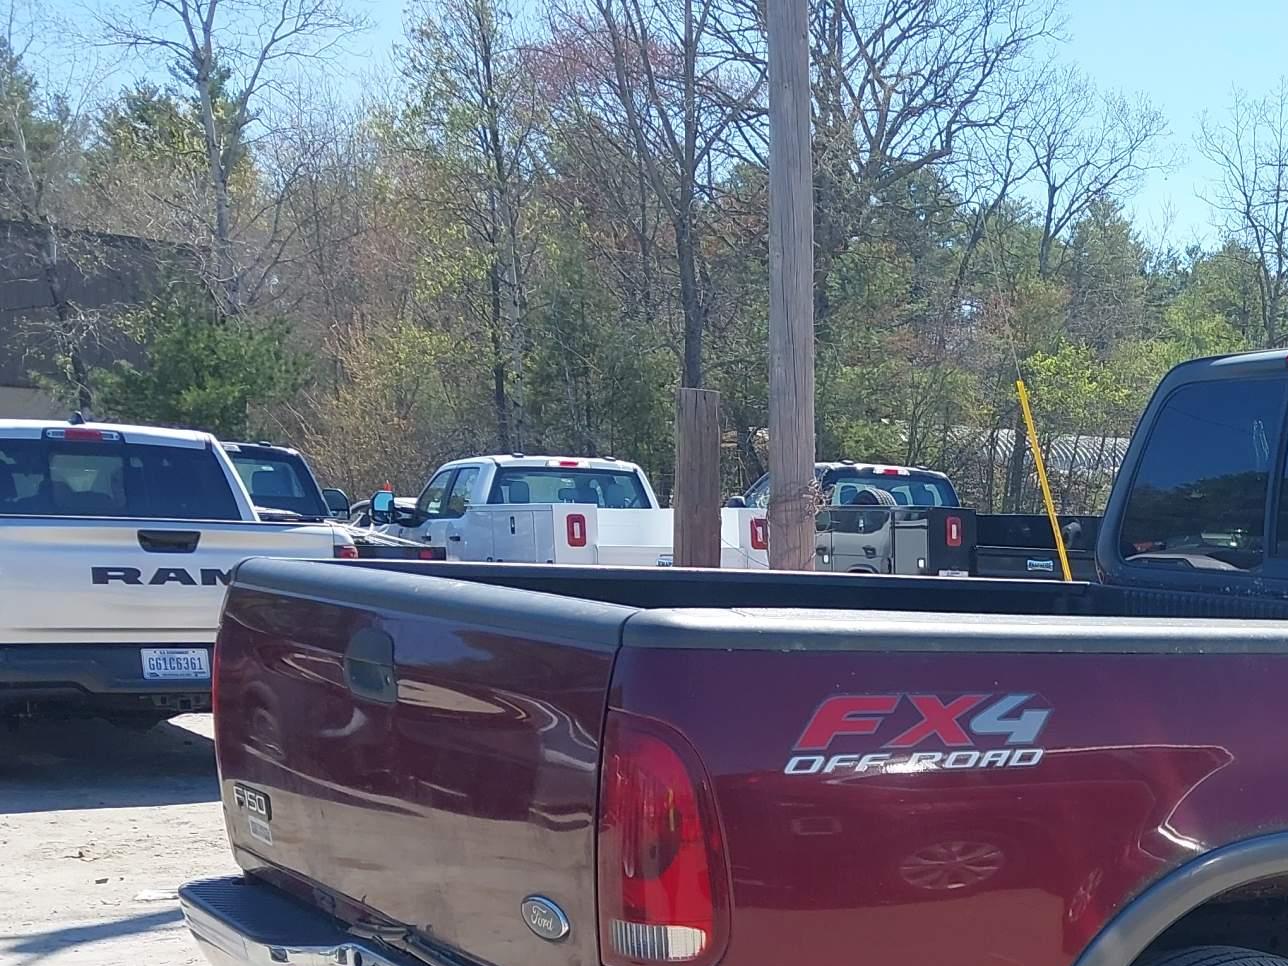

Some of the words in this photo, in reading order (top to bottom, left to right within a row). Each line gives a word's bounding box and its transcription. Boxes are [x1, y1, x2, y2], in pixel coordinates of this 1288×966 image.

[148, 657, 204, 671] G61C6361
[792, 694, 1053, 751] FX4
[784, 753, 892, 775] OFF
[902, 748, 1045, 771] ROAD
[530, 905, 554, 931] Ford
